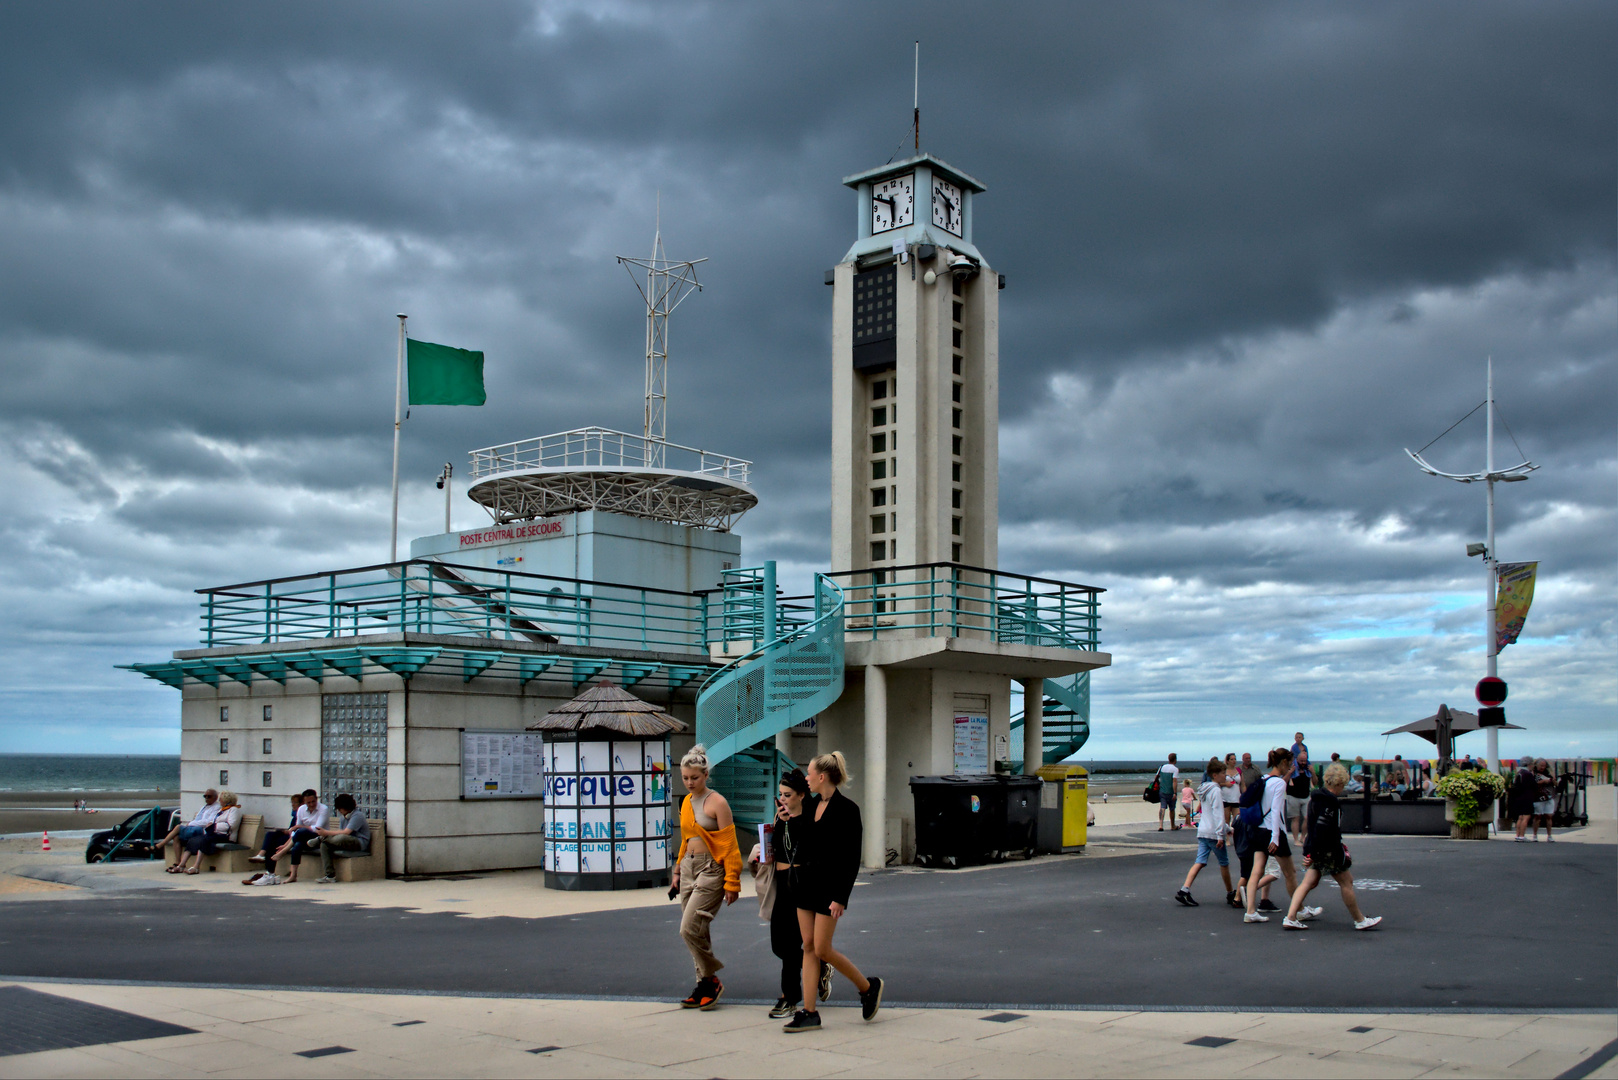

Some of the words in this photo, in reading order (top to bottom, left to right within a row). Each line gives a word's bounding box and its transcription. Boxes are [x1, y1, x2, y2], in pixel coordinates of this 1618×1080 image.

[883, 185, 888, 193] 11
[939, 182, 944, 190] 11
[944, 183, 950, 191] 12
[460, 533, 482, 545] POSTE
[483, 528, 515, 542] CENTRAL
[516, 527, 526, 537] DE
[527, 521, 562, 536] SECOURS
[555, 843, 578, 852] PLAGE
[598, 843, 627, 852] NORD
